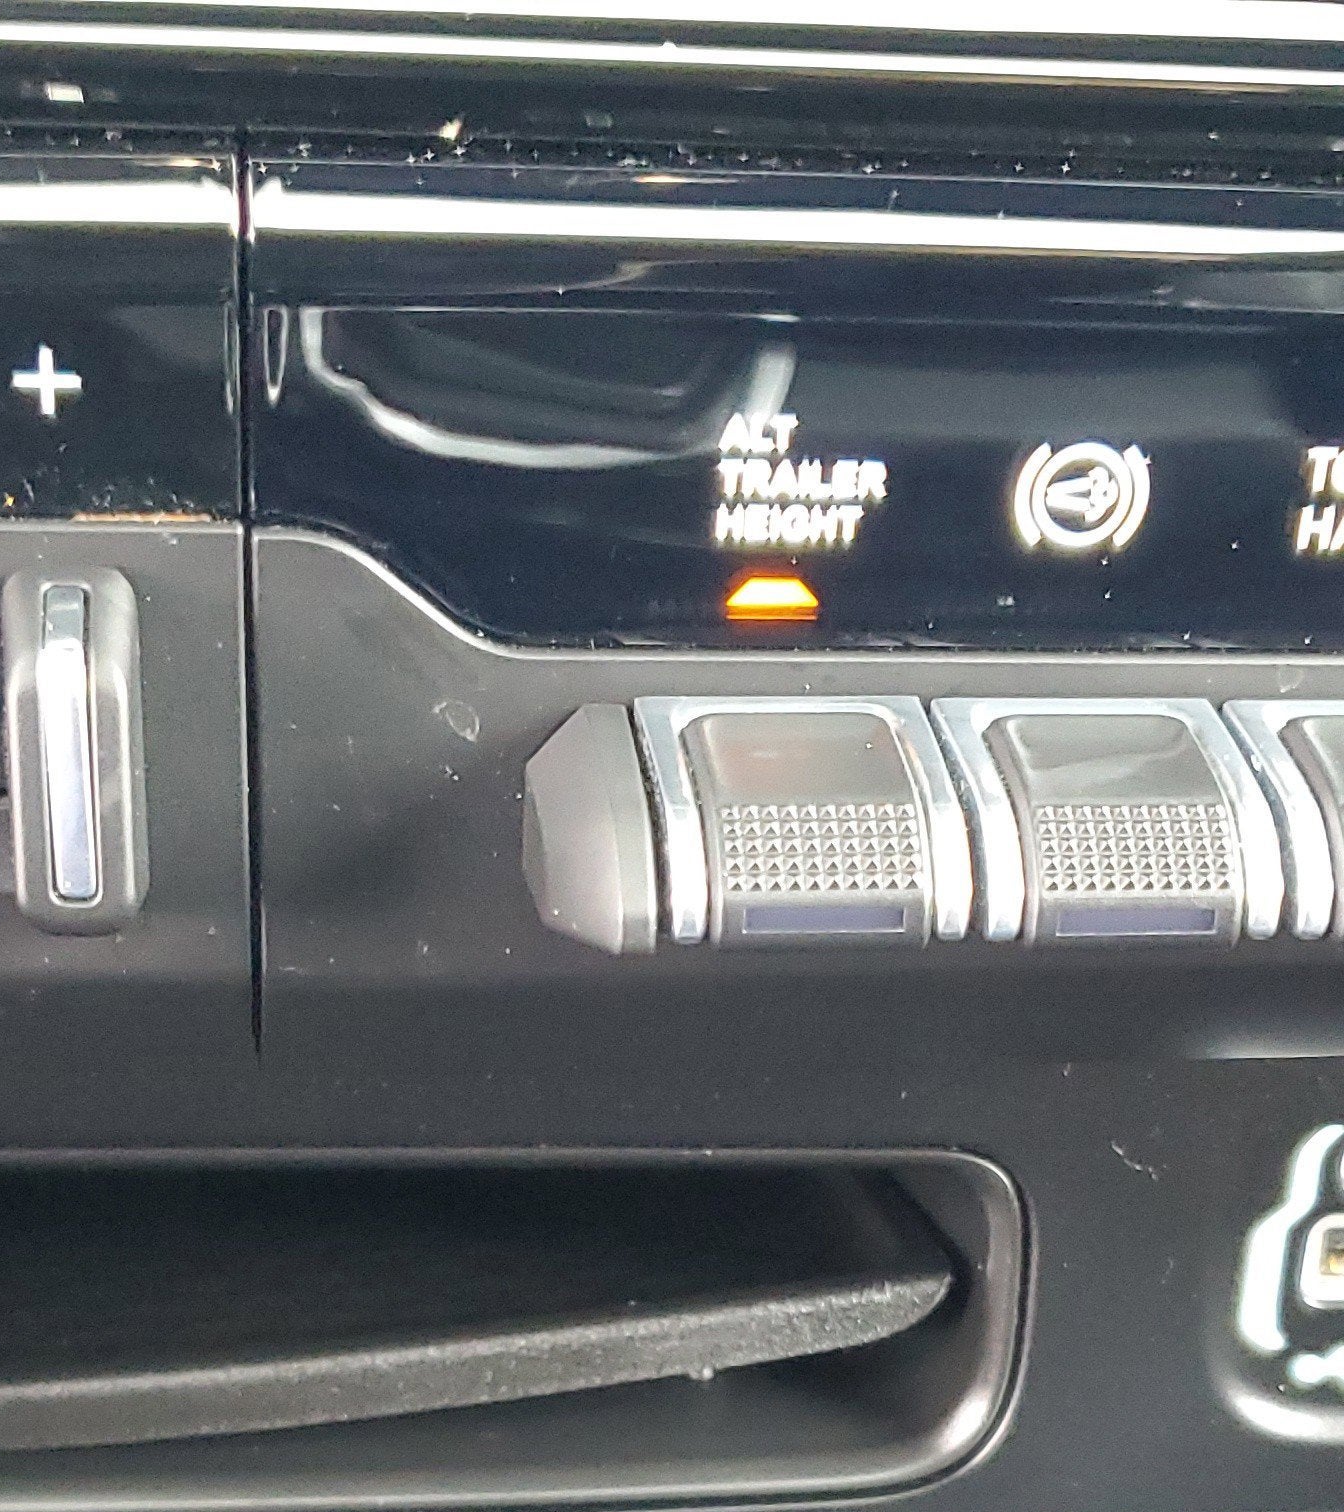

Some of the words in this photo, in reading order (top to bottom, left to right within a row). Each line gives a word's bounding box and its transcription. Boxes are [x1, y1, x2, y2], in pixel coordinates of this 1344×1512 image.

[717, 411, 799, 455] ALT
[716, 458, 887, 500] TRAILER
[714, 503, 865, 545] HEIGHT
